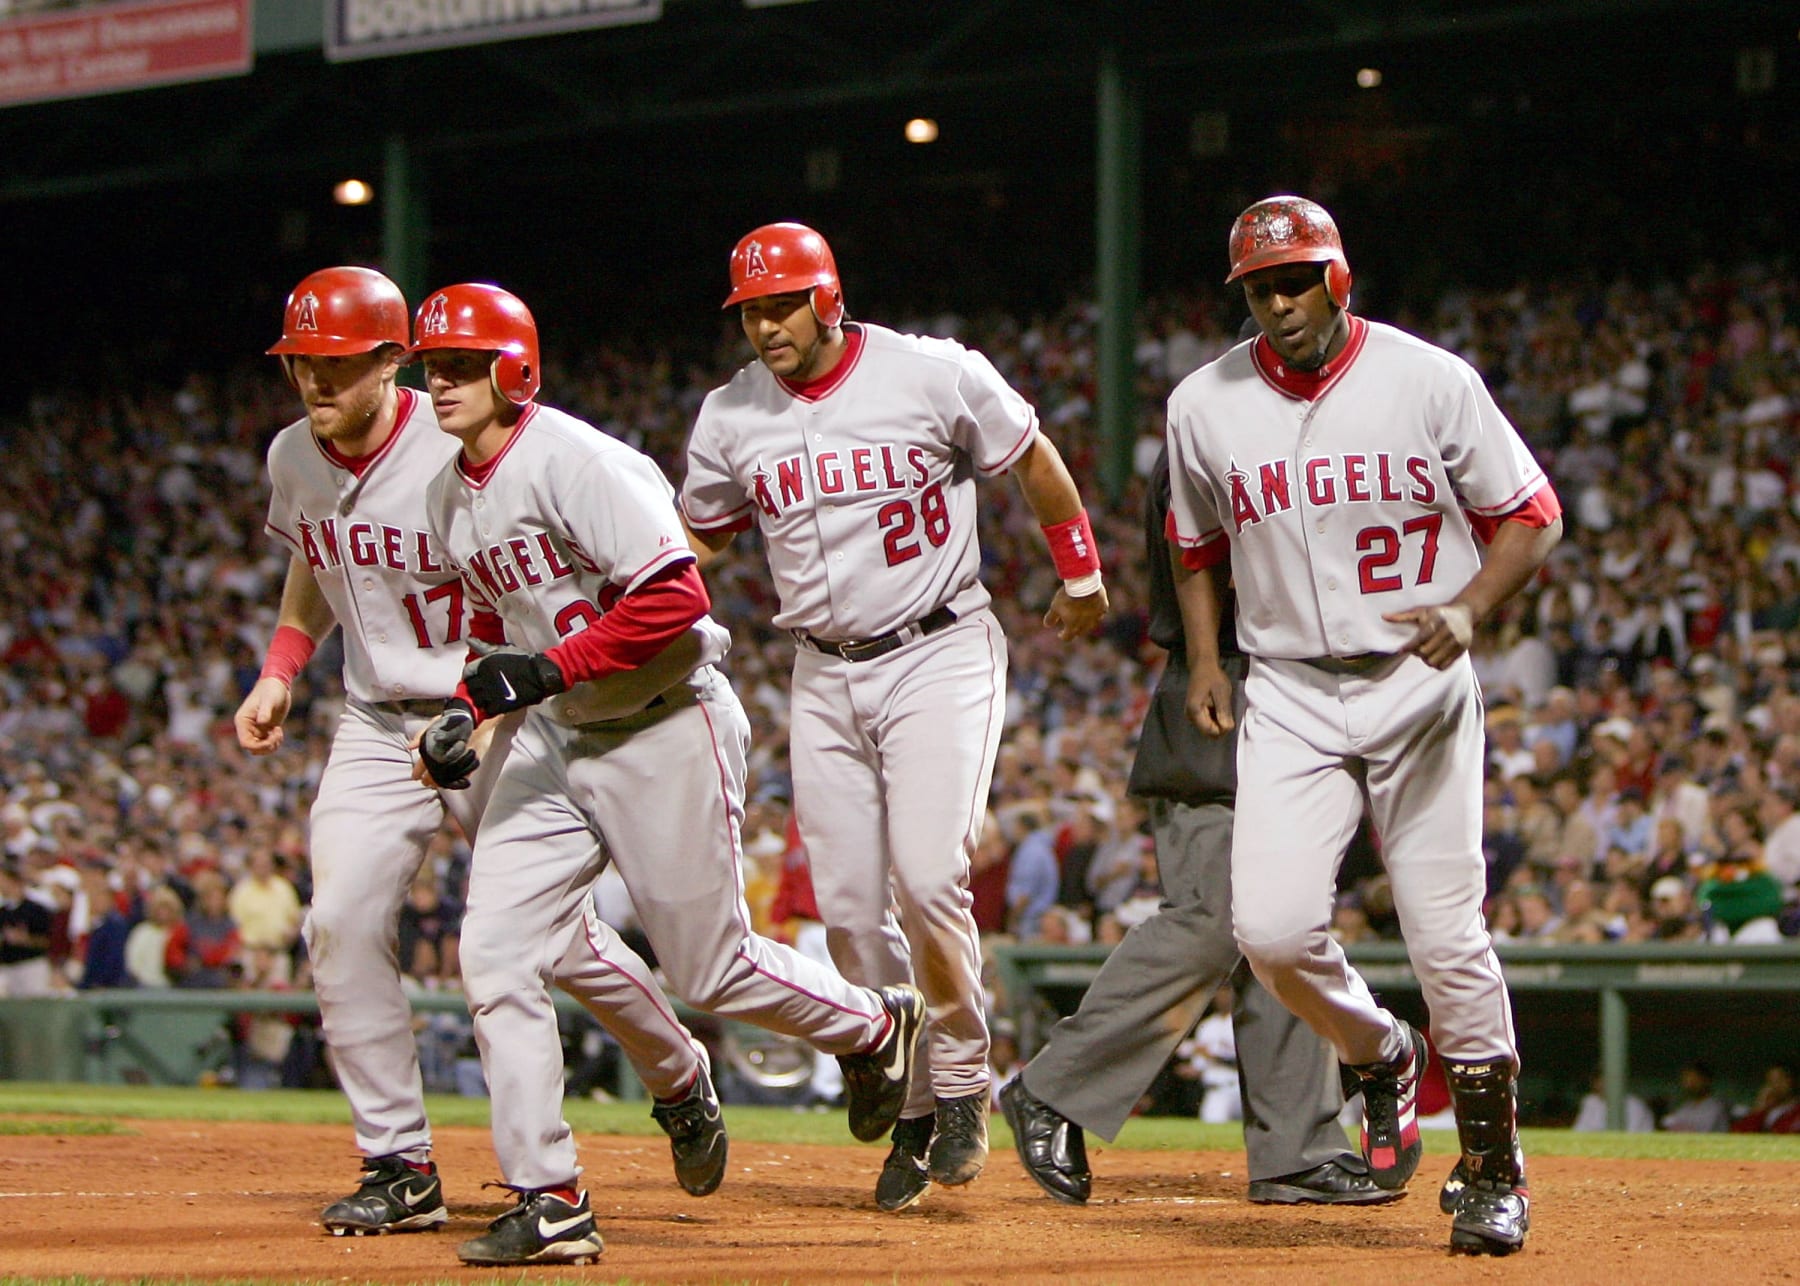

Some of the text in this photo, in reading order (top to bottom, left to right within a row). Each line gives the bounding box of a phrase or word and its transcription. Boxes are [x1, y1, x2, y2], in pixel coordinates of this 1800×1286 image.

[746, 240, 768, 277] A
[296, 291, 318, 331] A
[425, 293, 449, 333] A
[750, 444, 930, 520] ANGELS
[1223, 451, 1438, 535] ANGELS
[296, 513, 461, 573] ANGEL
[877, 481, 951, 567] 28
[1355, 512, 1443, 594] 27
[402, 579, 464, 648] 17
